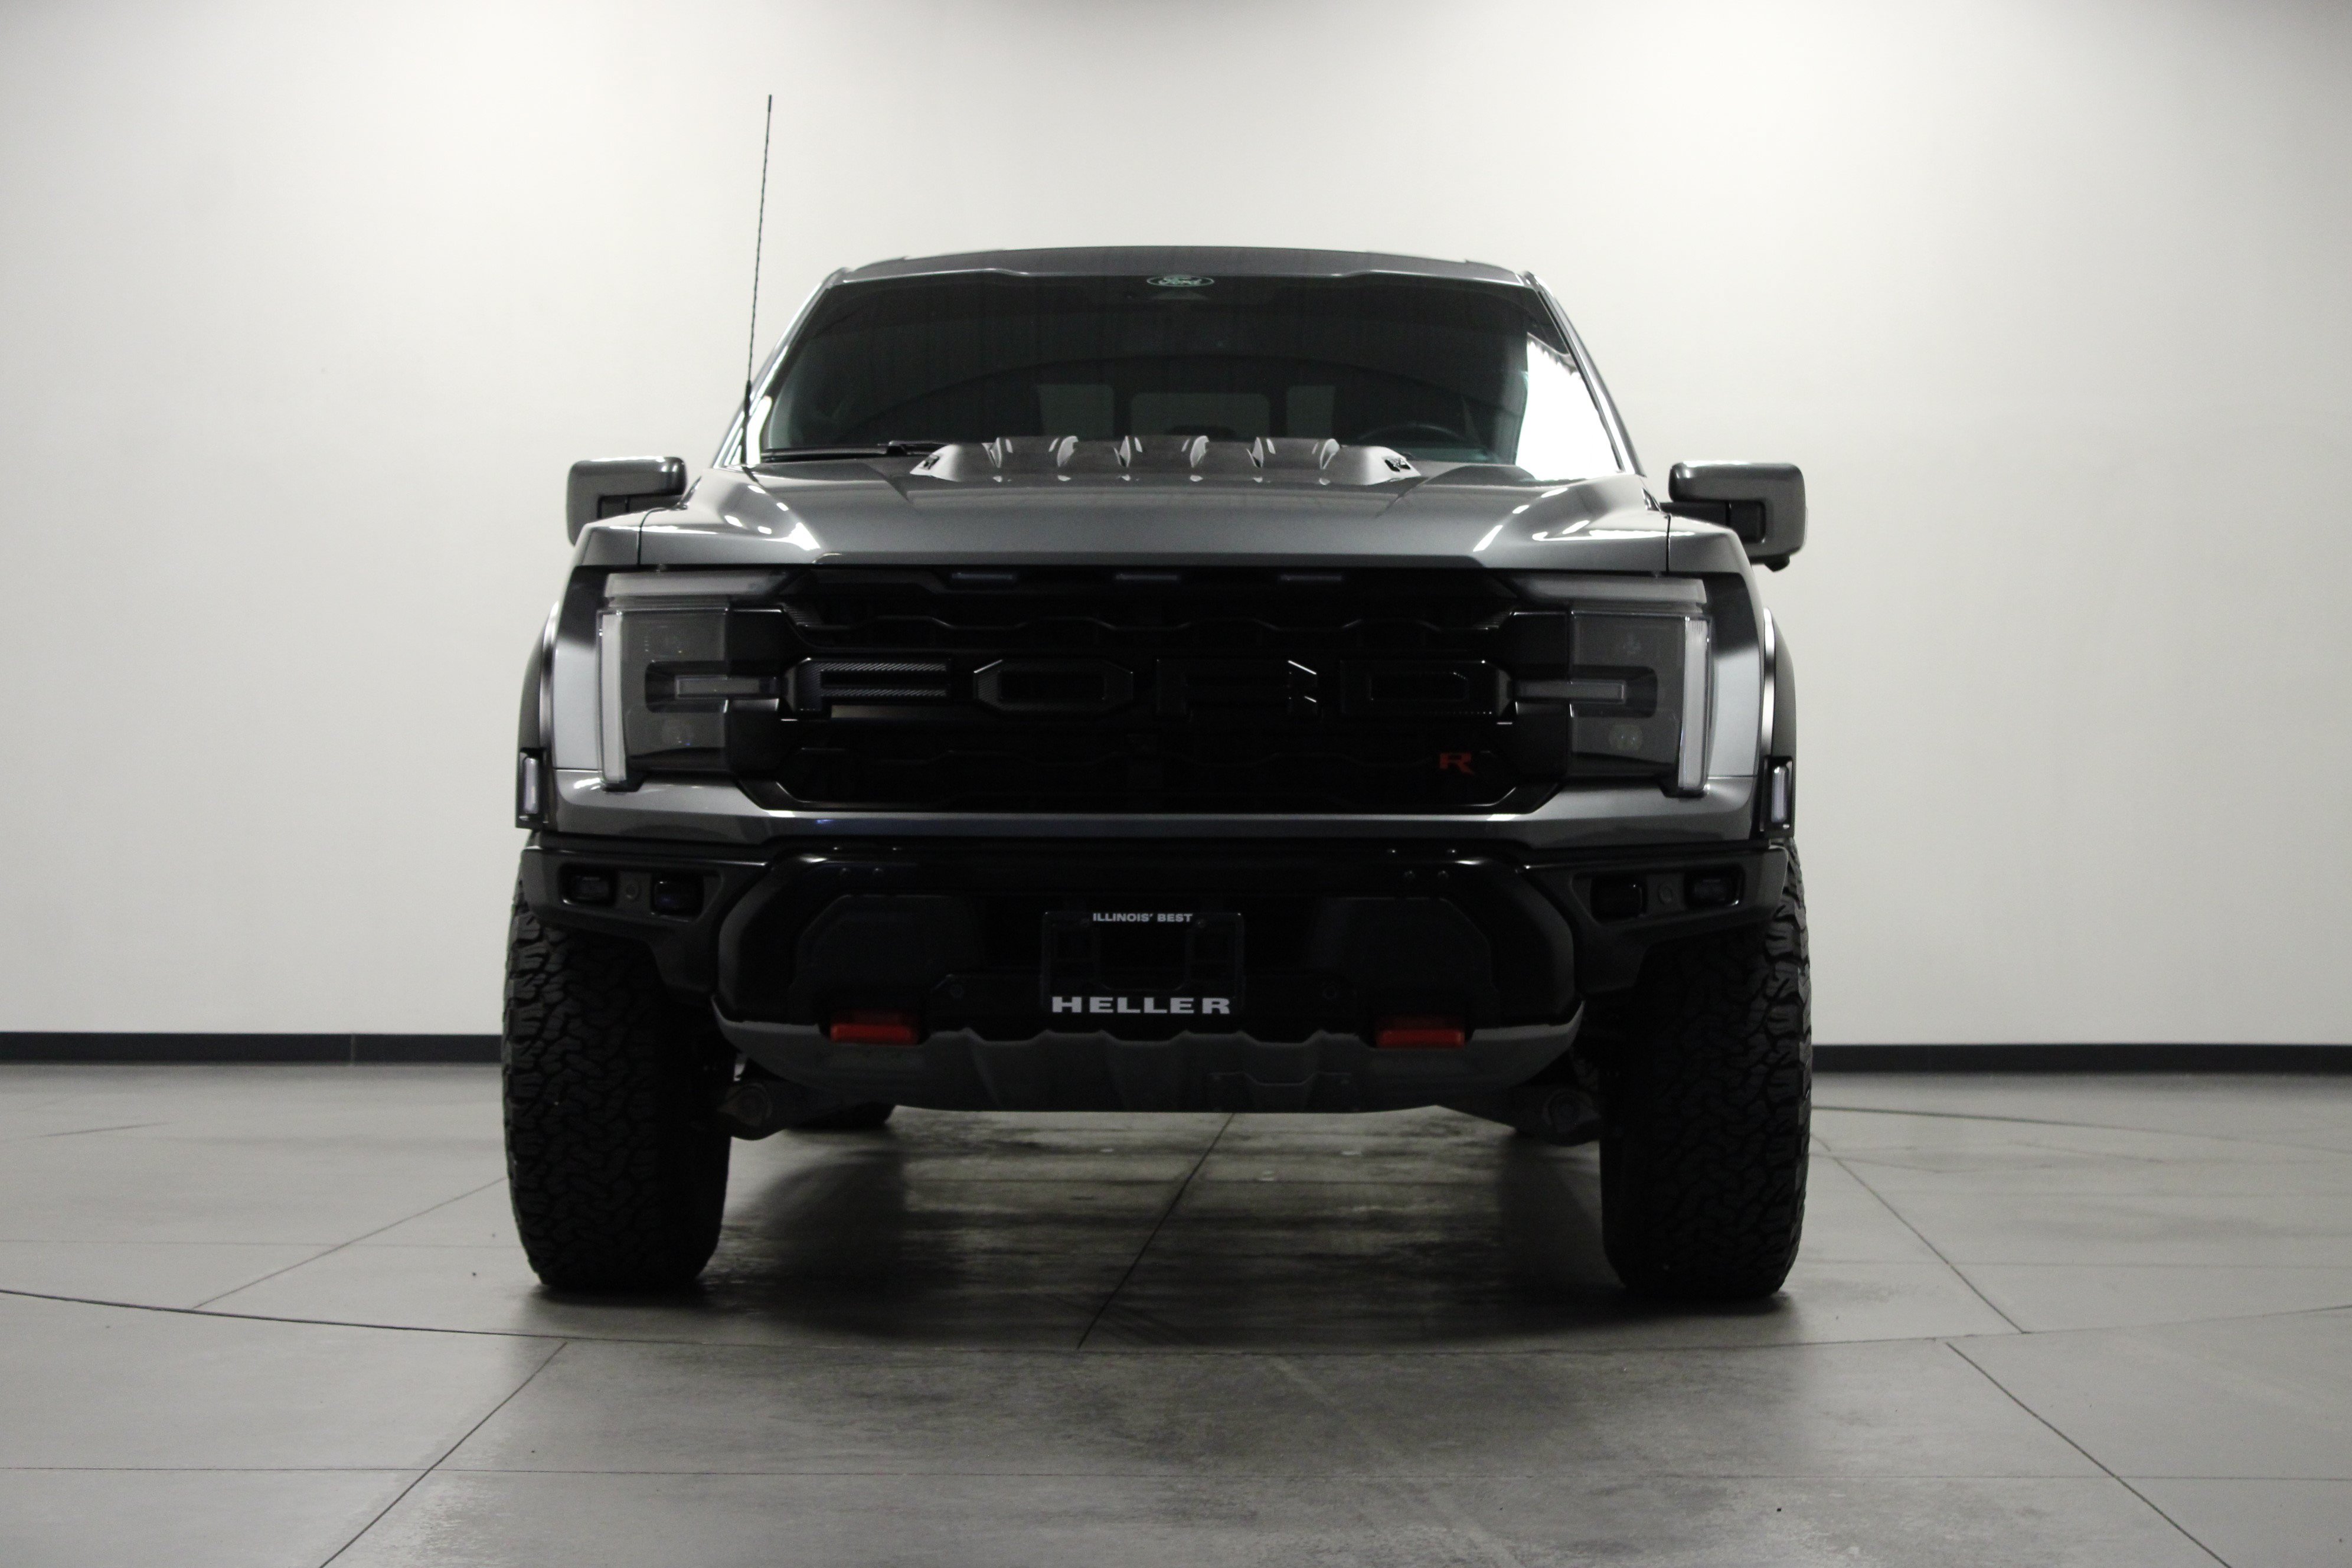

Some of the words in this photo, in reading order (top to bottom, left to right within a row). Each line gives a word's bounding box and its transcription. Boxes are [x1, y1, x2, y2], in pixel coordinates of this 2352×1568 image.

[784, 656, 1510, 720] FORD
[1439, 751, 1475, 776] R
[1093, 913, 1153, 922] ILLINOIS'
[1157, 913, 1193, 923] BEST
[1051, 996, 1231, 1015] HELLER
